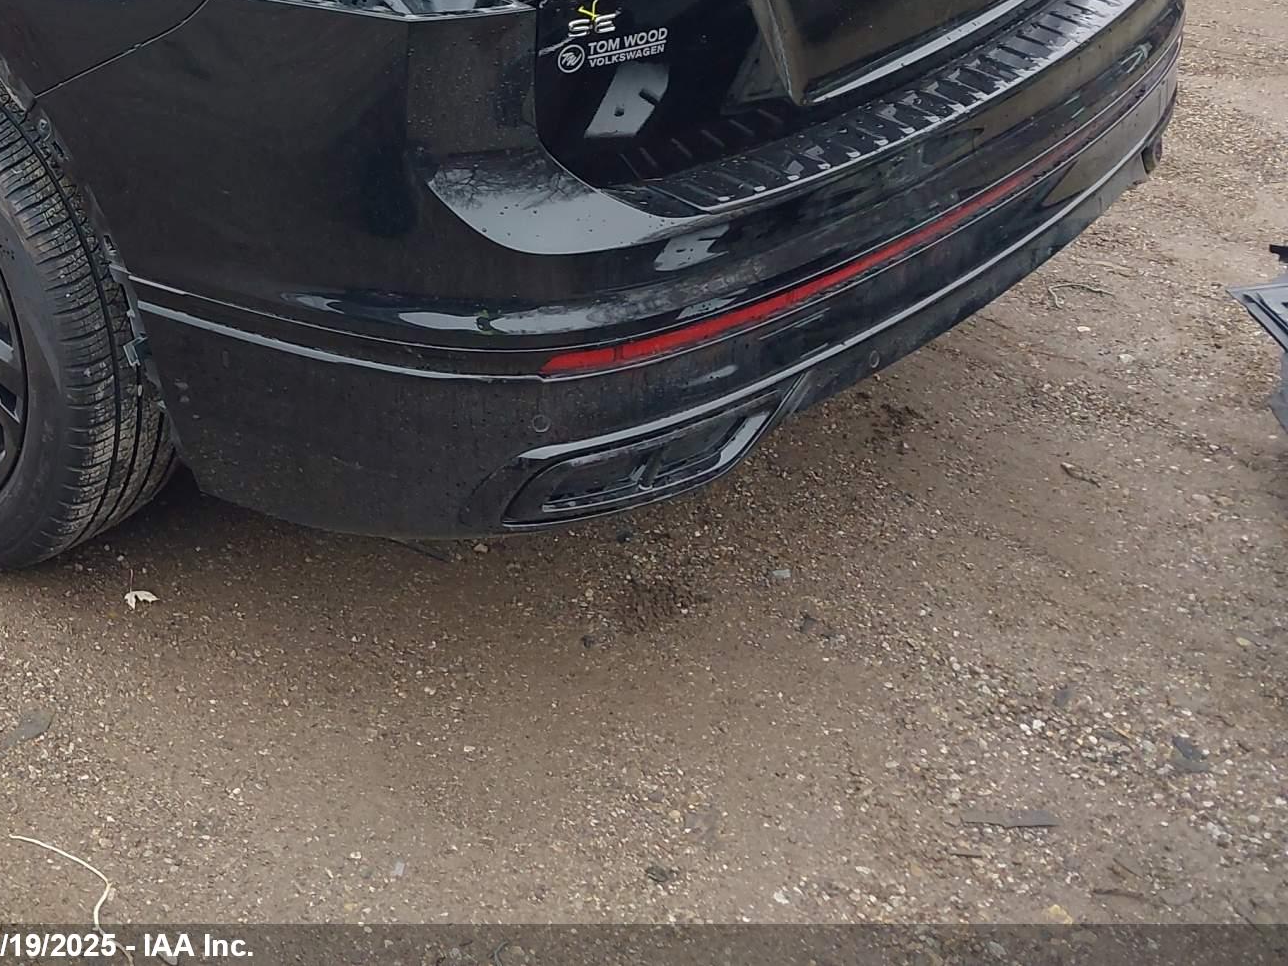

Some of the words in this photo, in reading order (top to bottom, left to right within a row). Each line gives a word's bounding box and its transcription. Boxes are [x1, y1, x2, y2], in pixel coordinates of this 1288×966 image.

[588, 37, 620, 55] TOM
[623, 28, 668, 47] WOOD
[589, 44, 666, 68] VOLKSWAGEN
